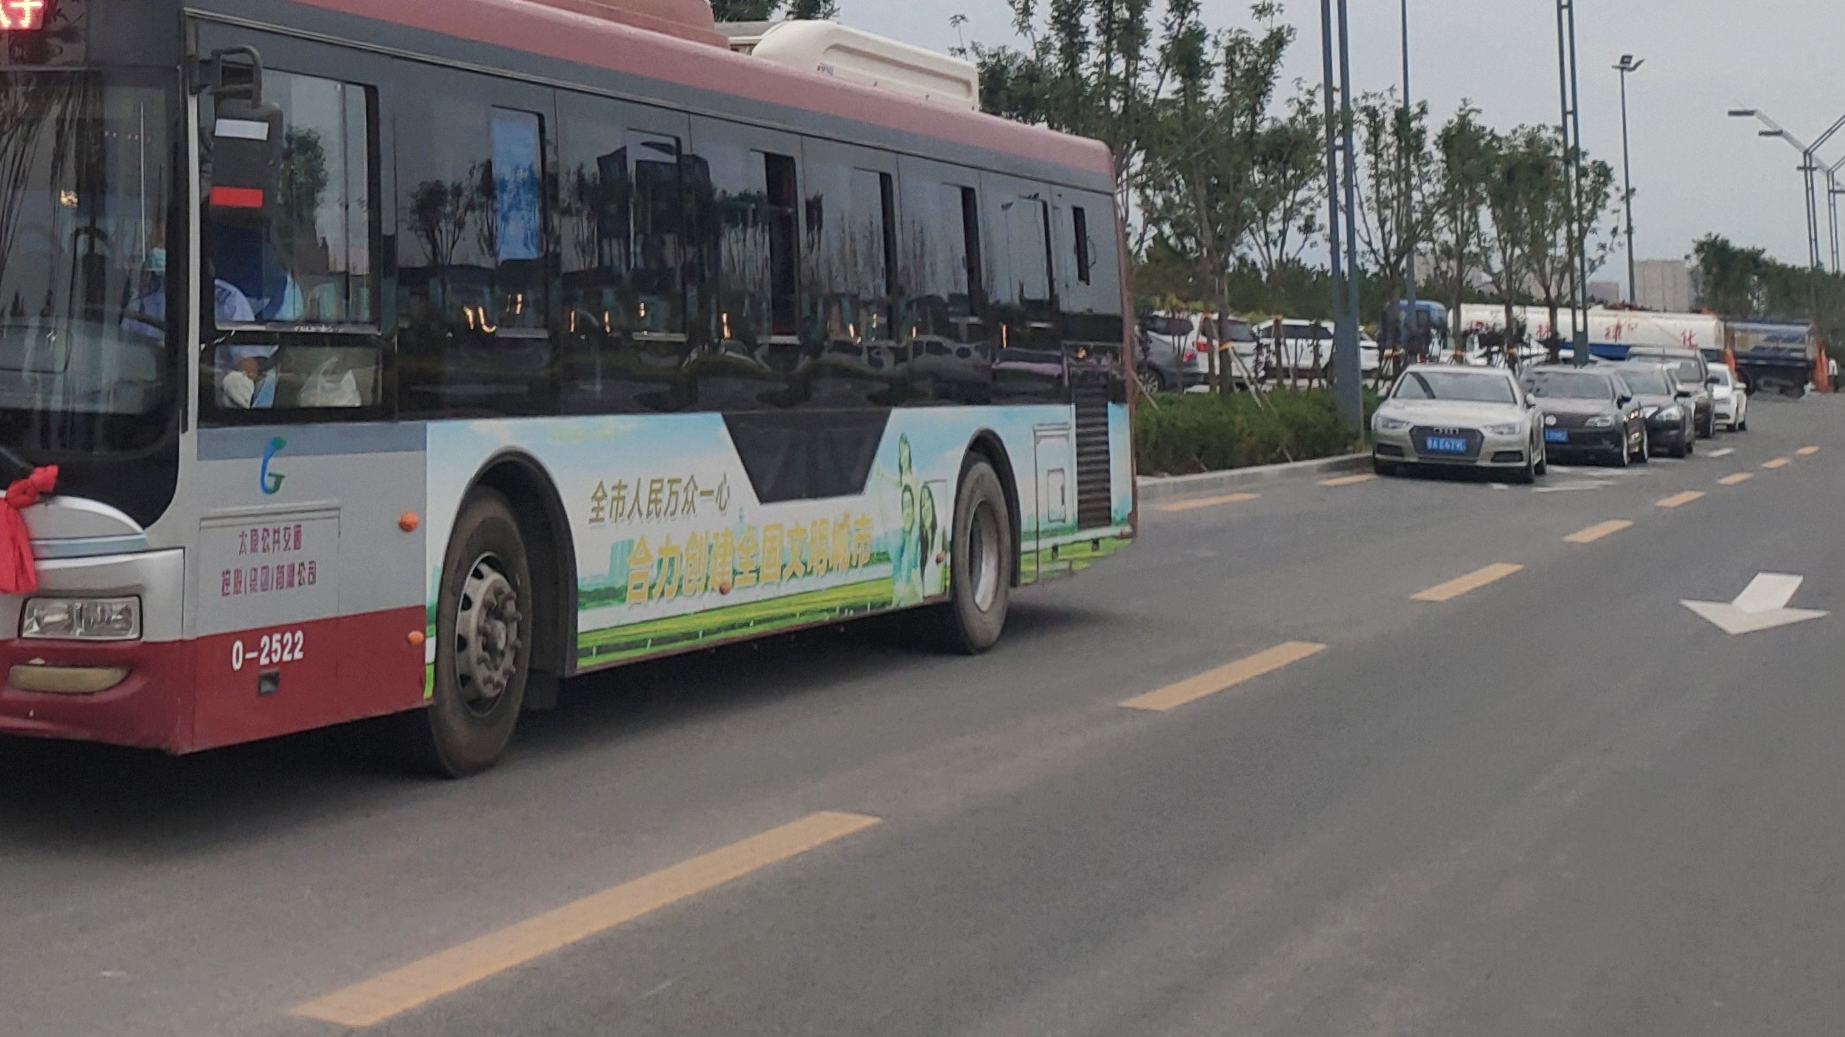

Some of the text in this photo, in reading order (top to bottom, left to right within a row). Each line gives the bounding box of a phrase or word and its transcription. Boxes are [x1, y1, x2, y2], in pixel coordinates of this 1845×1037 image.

[589, 473, 730, 524] 全市人民万众一心
[238, 523, 303, 556] 太原公共交通
[625, 511, 874, 604] 合力创建全国文明城市
